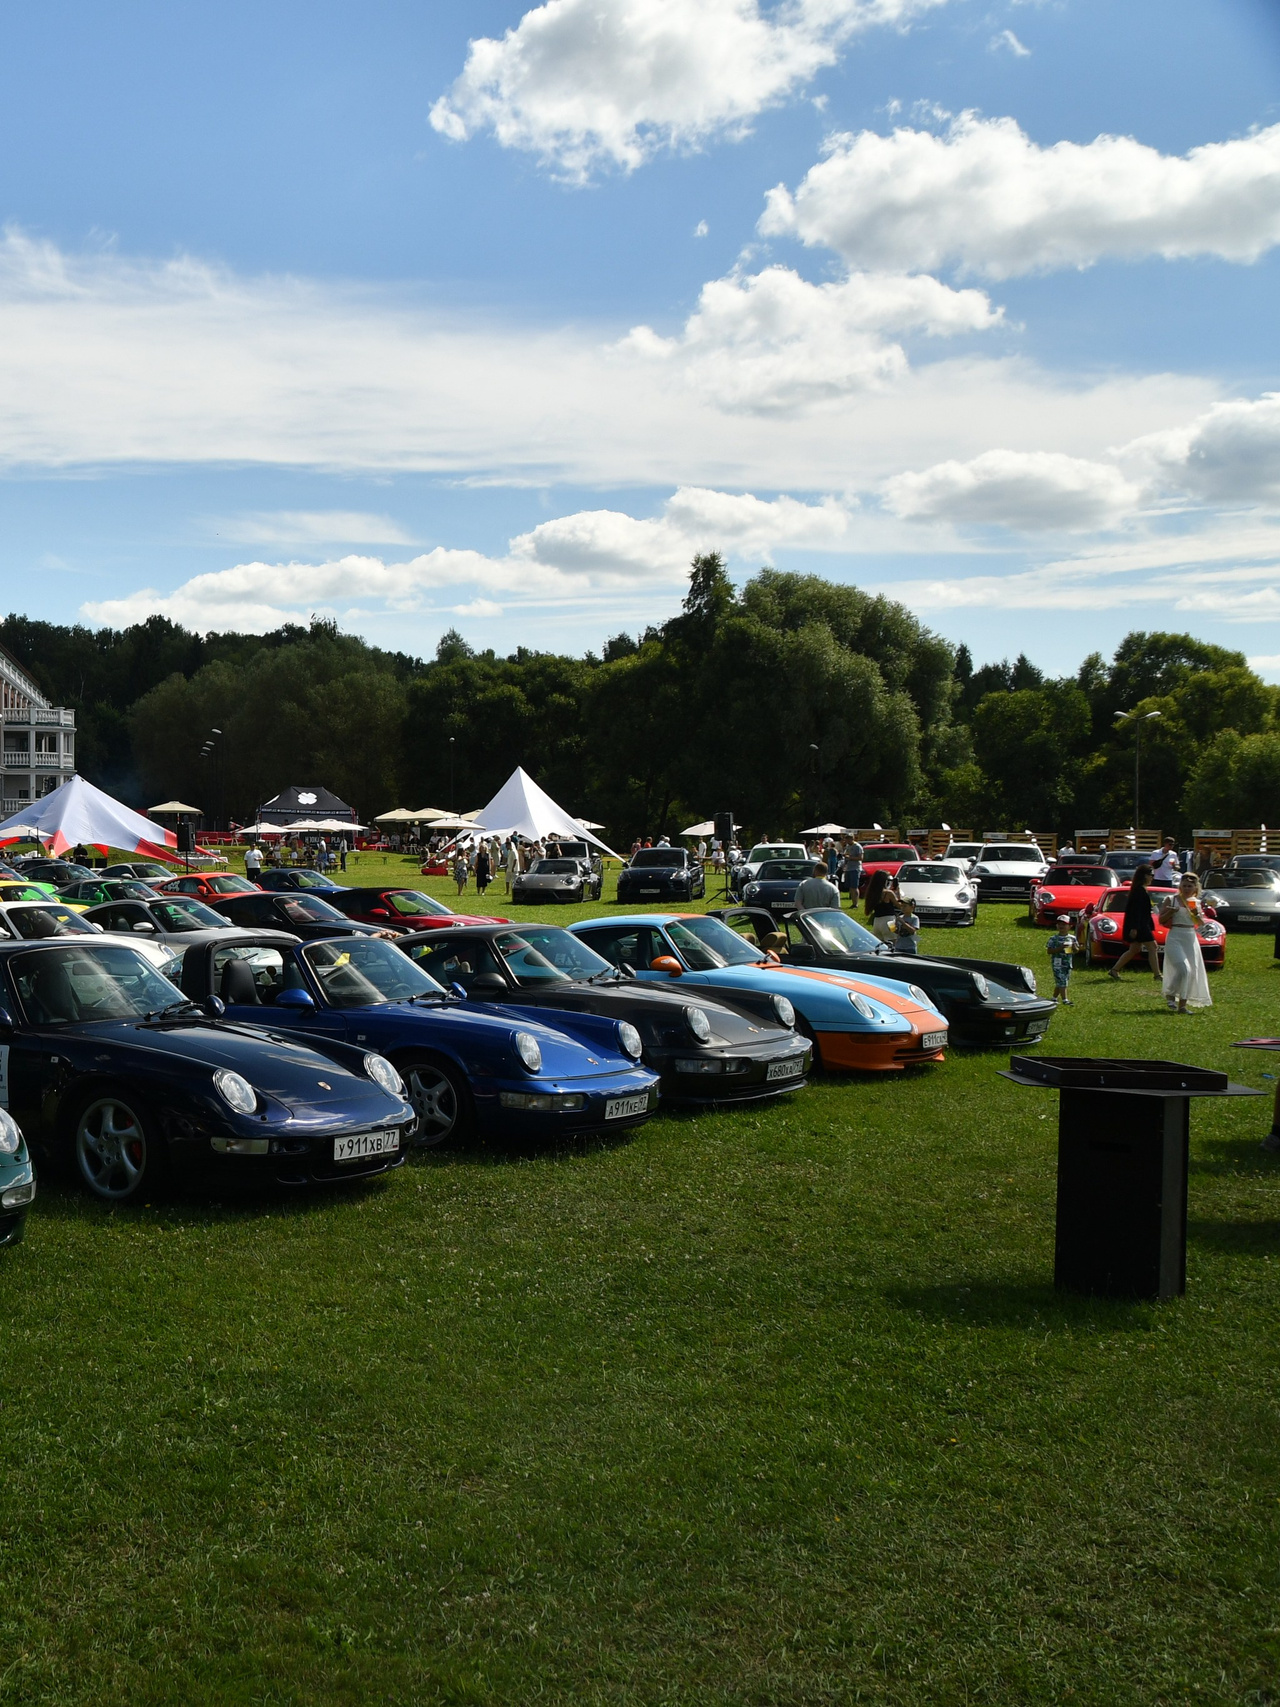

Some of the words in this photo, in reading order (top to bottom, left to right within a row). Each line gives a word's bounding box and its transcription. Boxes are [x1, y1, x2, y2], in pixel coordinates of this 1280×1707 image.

[609, 1100, 638, 1116] А911КЕ
[339, 1136, 383, 1157] У911ХВ
[385, 1131, 396, 1145] 77
